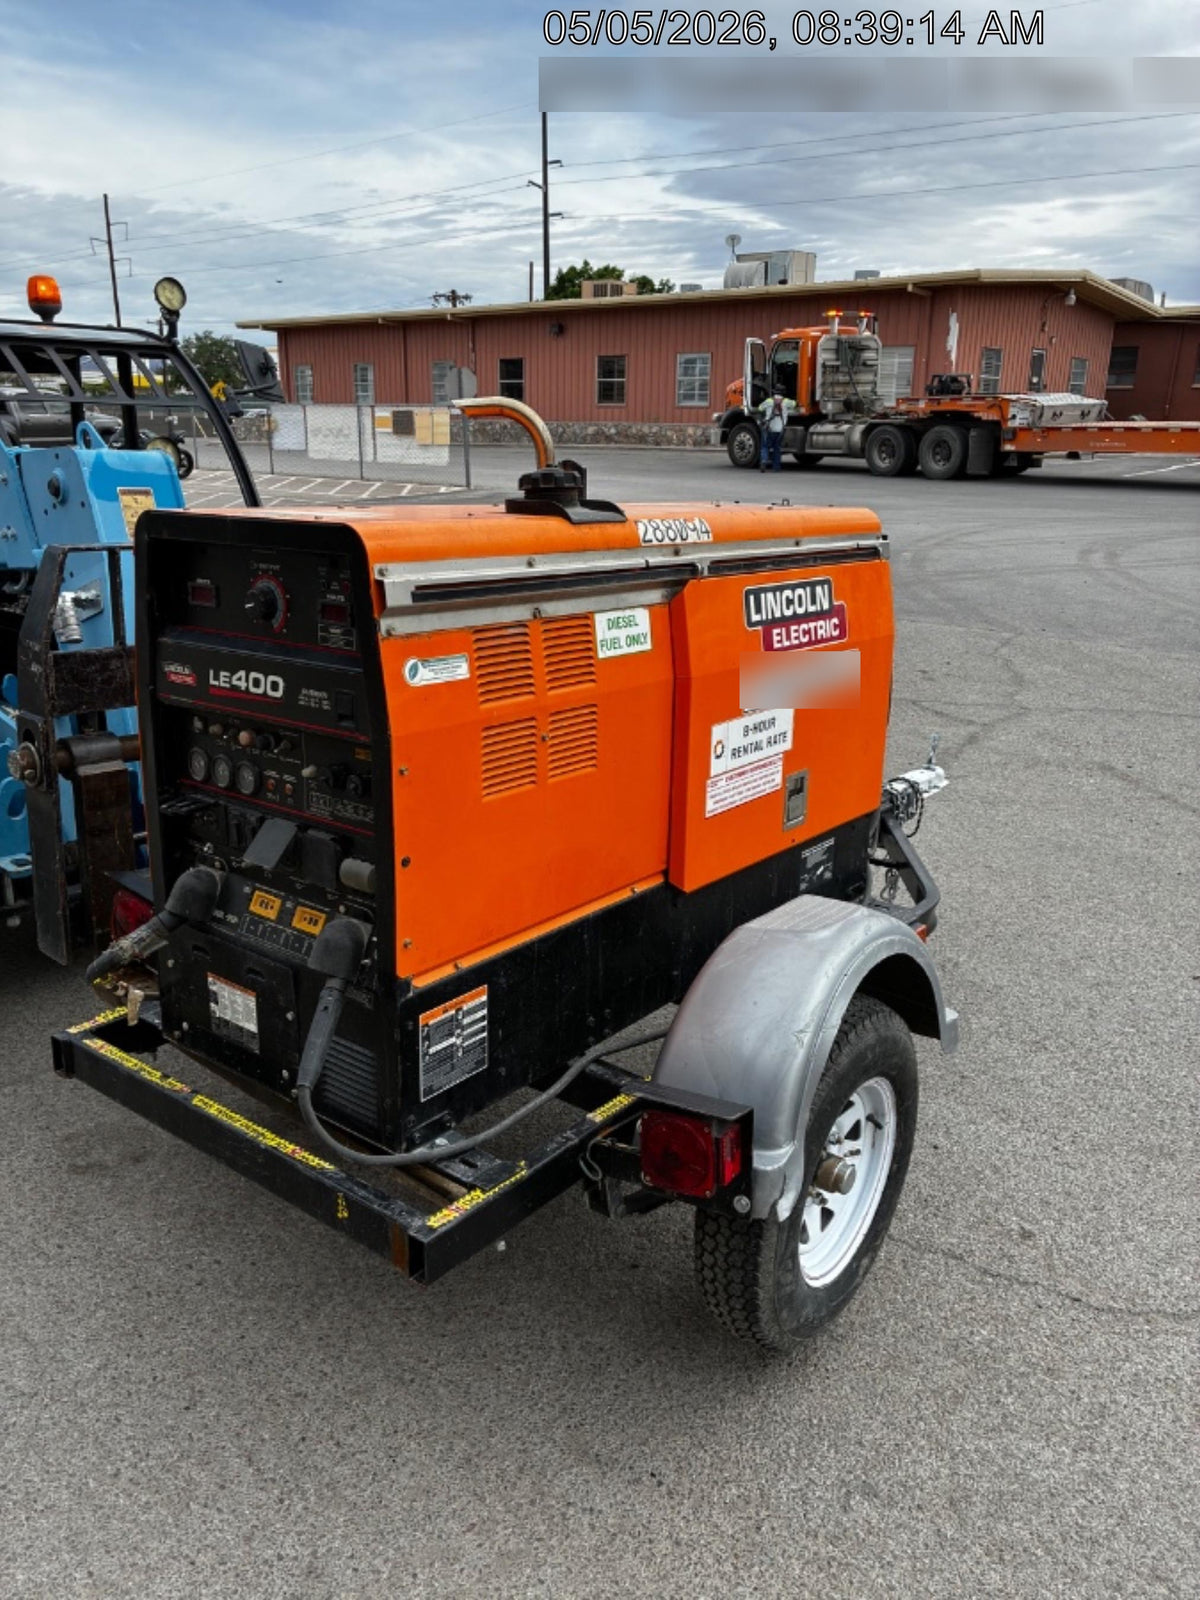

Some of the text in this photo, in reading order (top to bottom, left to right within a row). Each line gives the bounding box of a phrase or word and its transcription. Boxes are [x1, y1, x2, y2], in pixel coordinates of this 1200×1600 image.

[748, 583, 831, 622] LINCOLN
[607, 615, 639, 631] DIESEL
[772, 616, 841, 649] ELECTRIC
[599, 632, 649, 652] FUEL ONLY
[208, 668, 285, 698] LE400
[743, 716, 776, 738] 8-HOUR
[730, 731, 788, 760] RENTAL RATE
